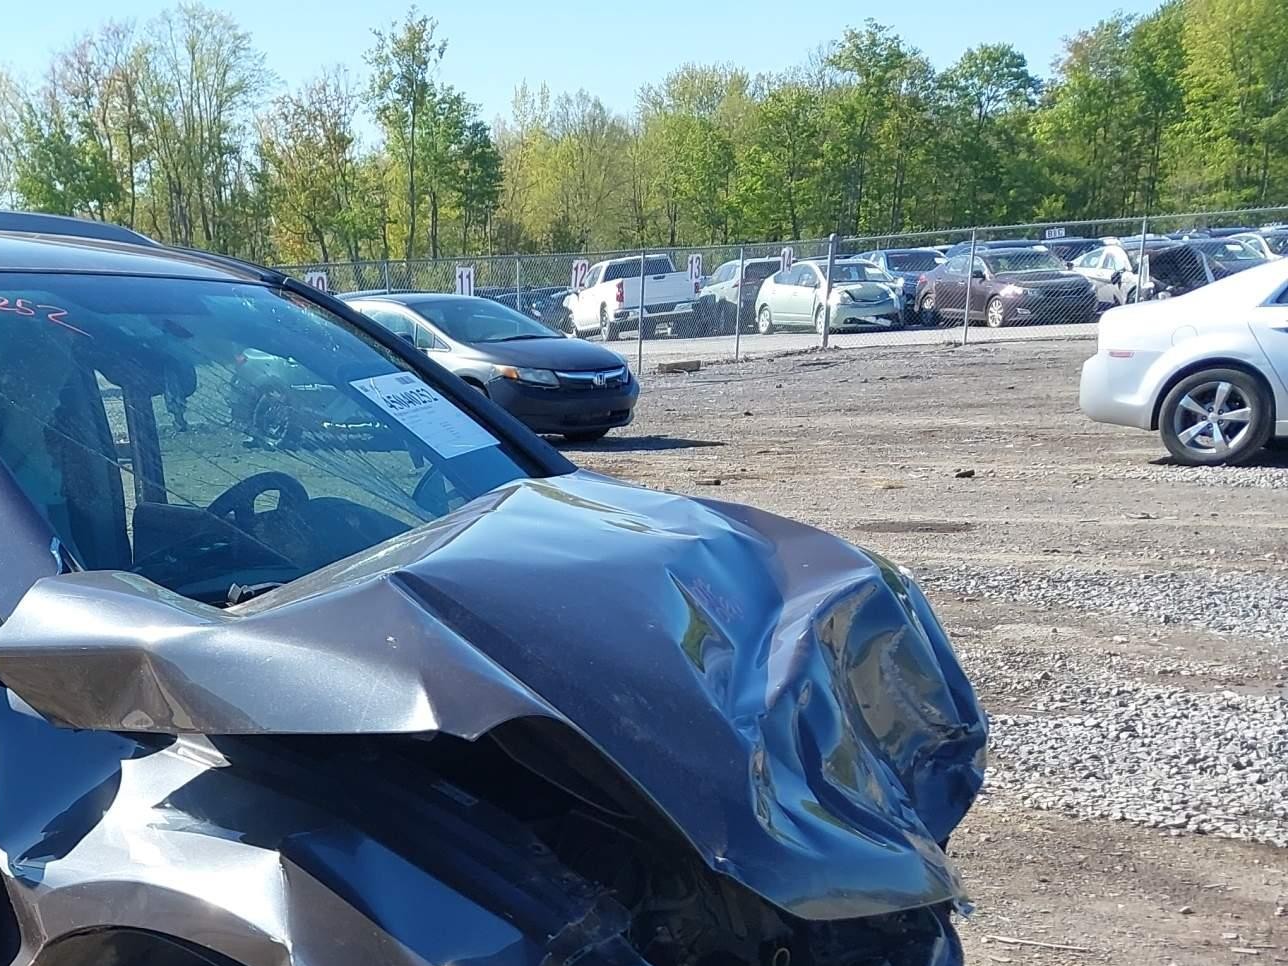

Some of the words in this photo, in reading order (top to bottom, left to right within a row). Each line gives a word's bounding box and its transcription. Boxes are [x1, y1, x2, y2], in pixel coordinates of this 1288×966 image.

[689, 256, 701, 280] 13
[782, 250, 792, 272] 14
[458, 270, 472, 297] 11
[573, 263, 587, 288] 12
